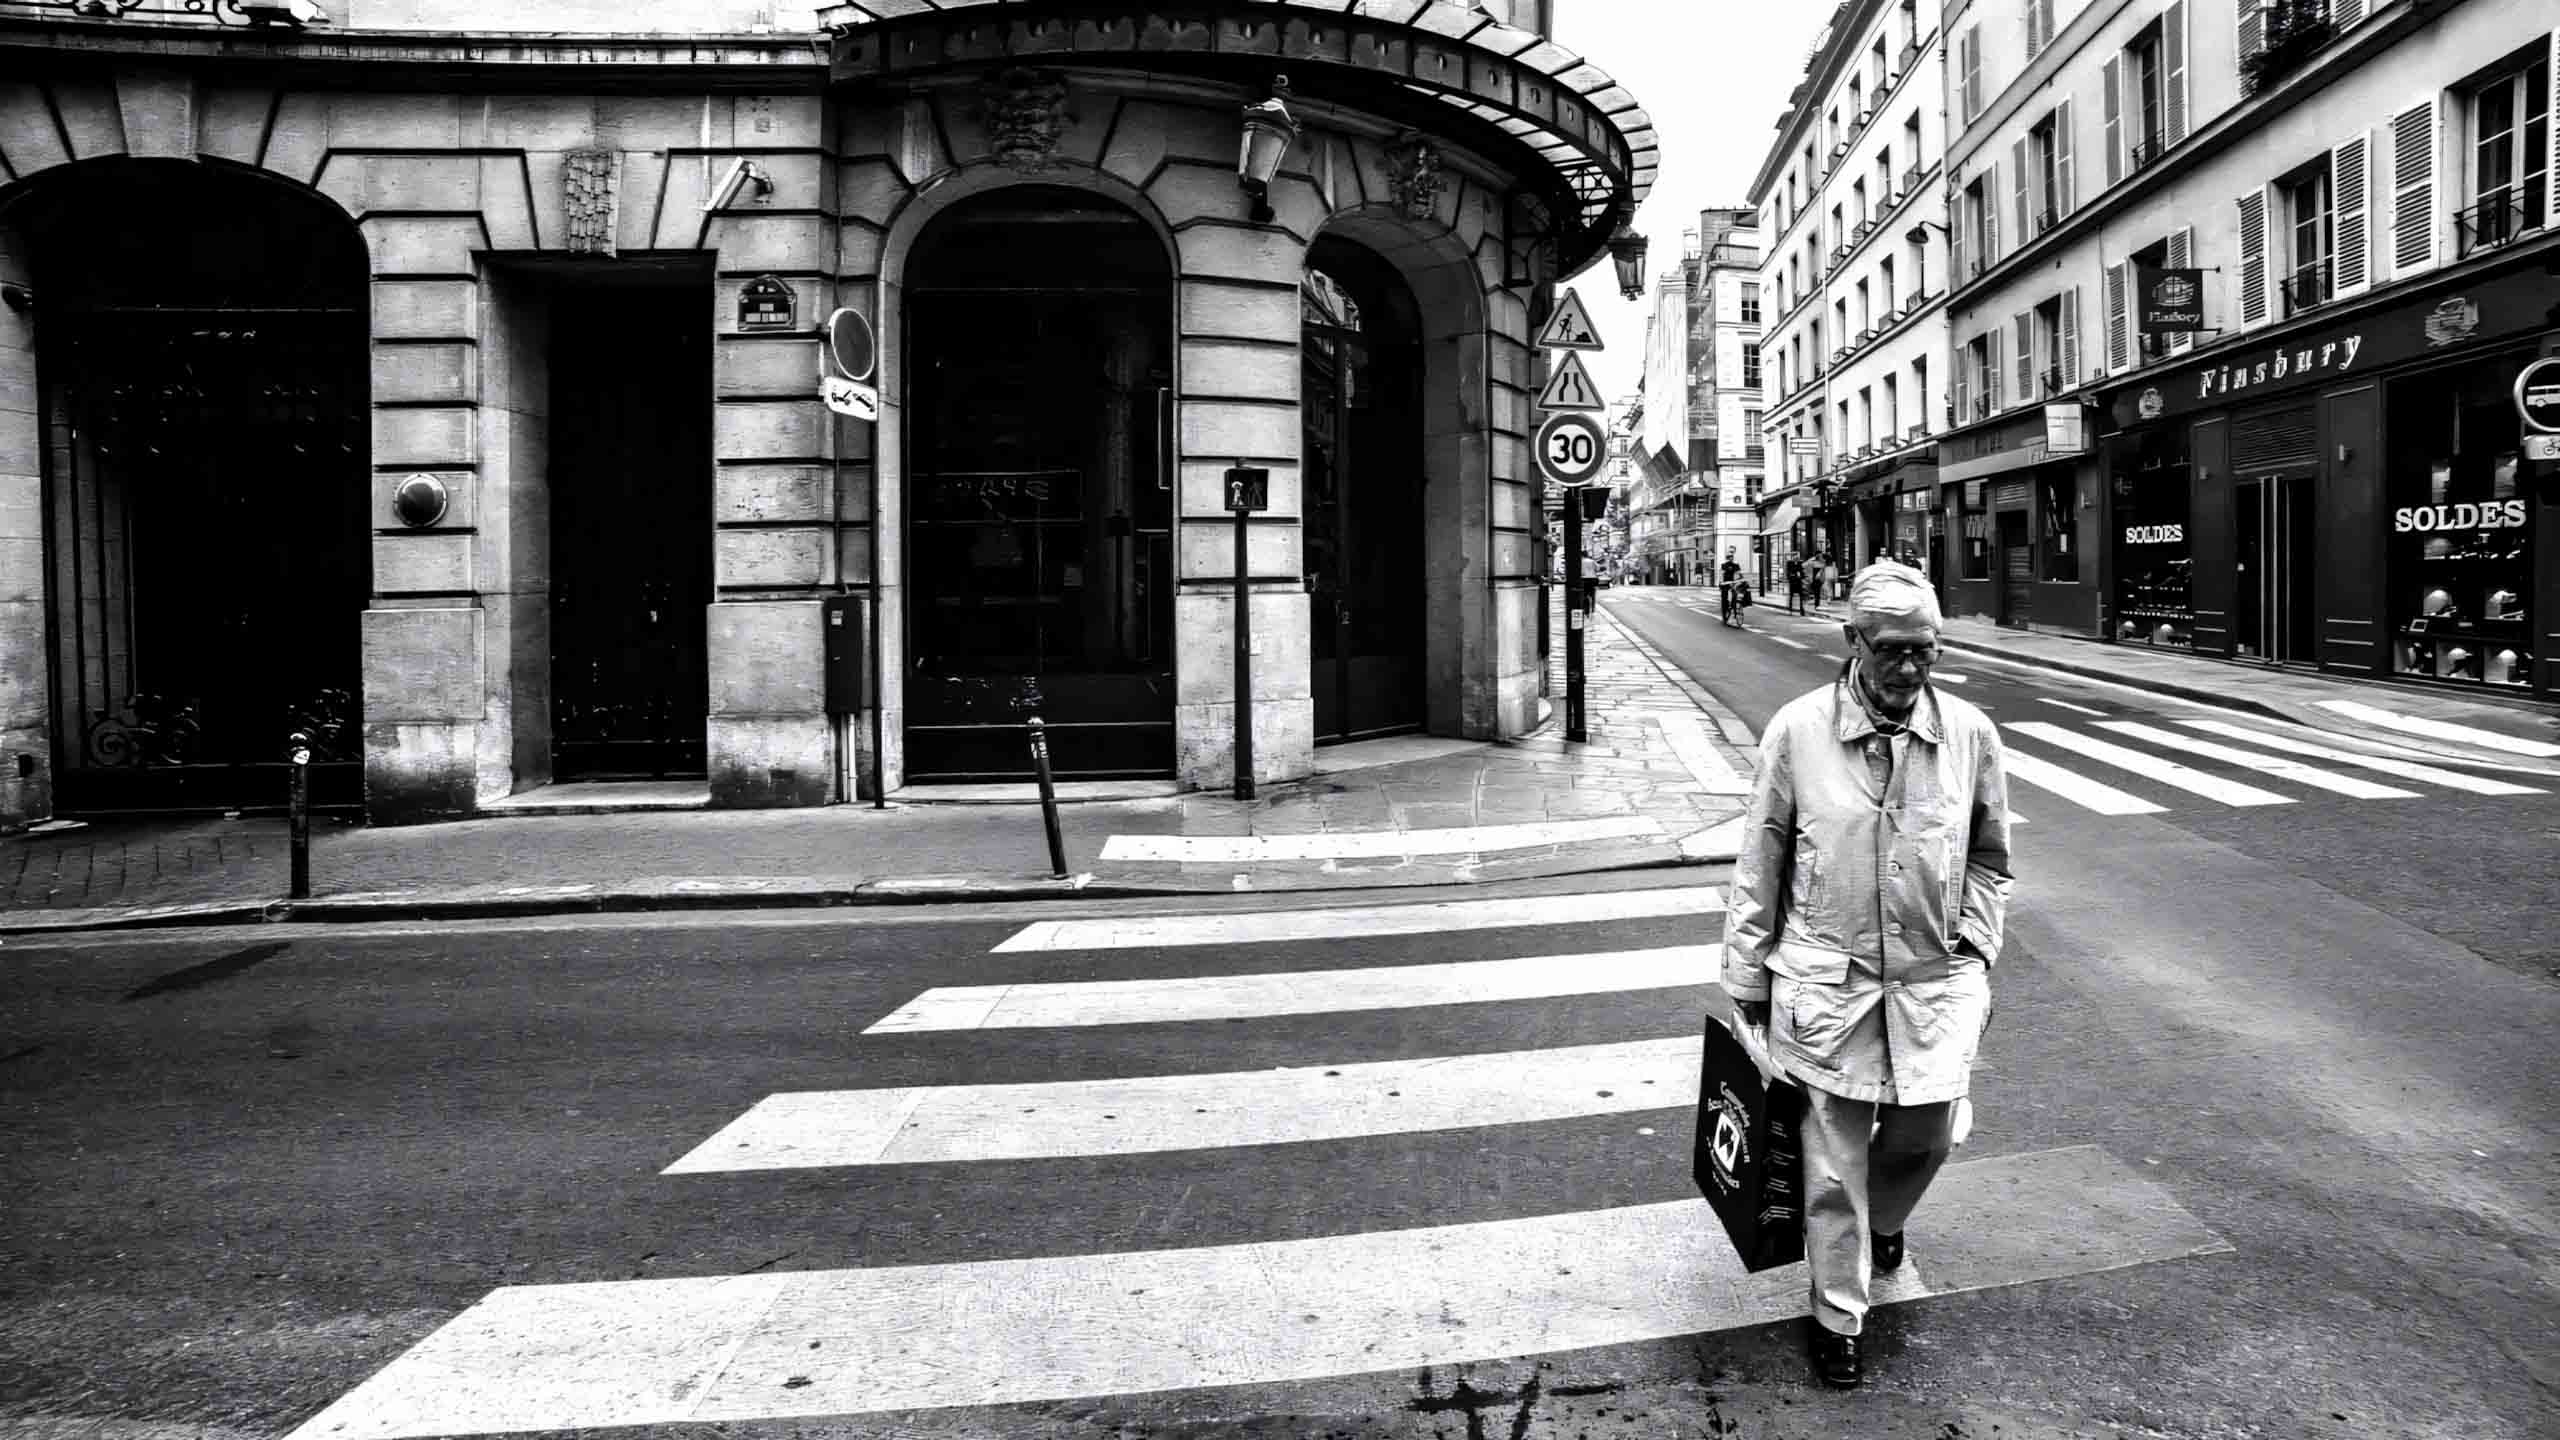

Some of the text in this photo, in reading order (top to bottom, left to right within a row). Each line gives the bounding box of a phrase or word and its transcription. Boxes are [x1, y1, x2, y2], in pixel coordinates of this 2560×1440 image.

[2197, 336, 2361, 399] Finsbury
[1551, 434, 1592, 464] 30
[2395, 500, 2526, 532] SOLDES
[2126, 524, 2183, 543] SOLDES
